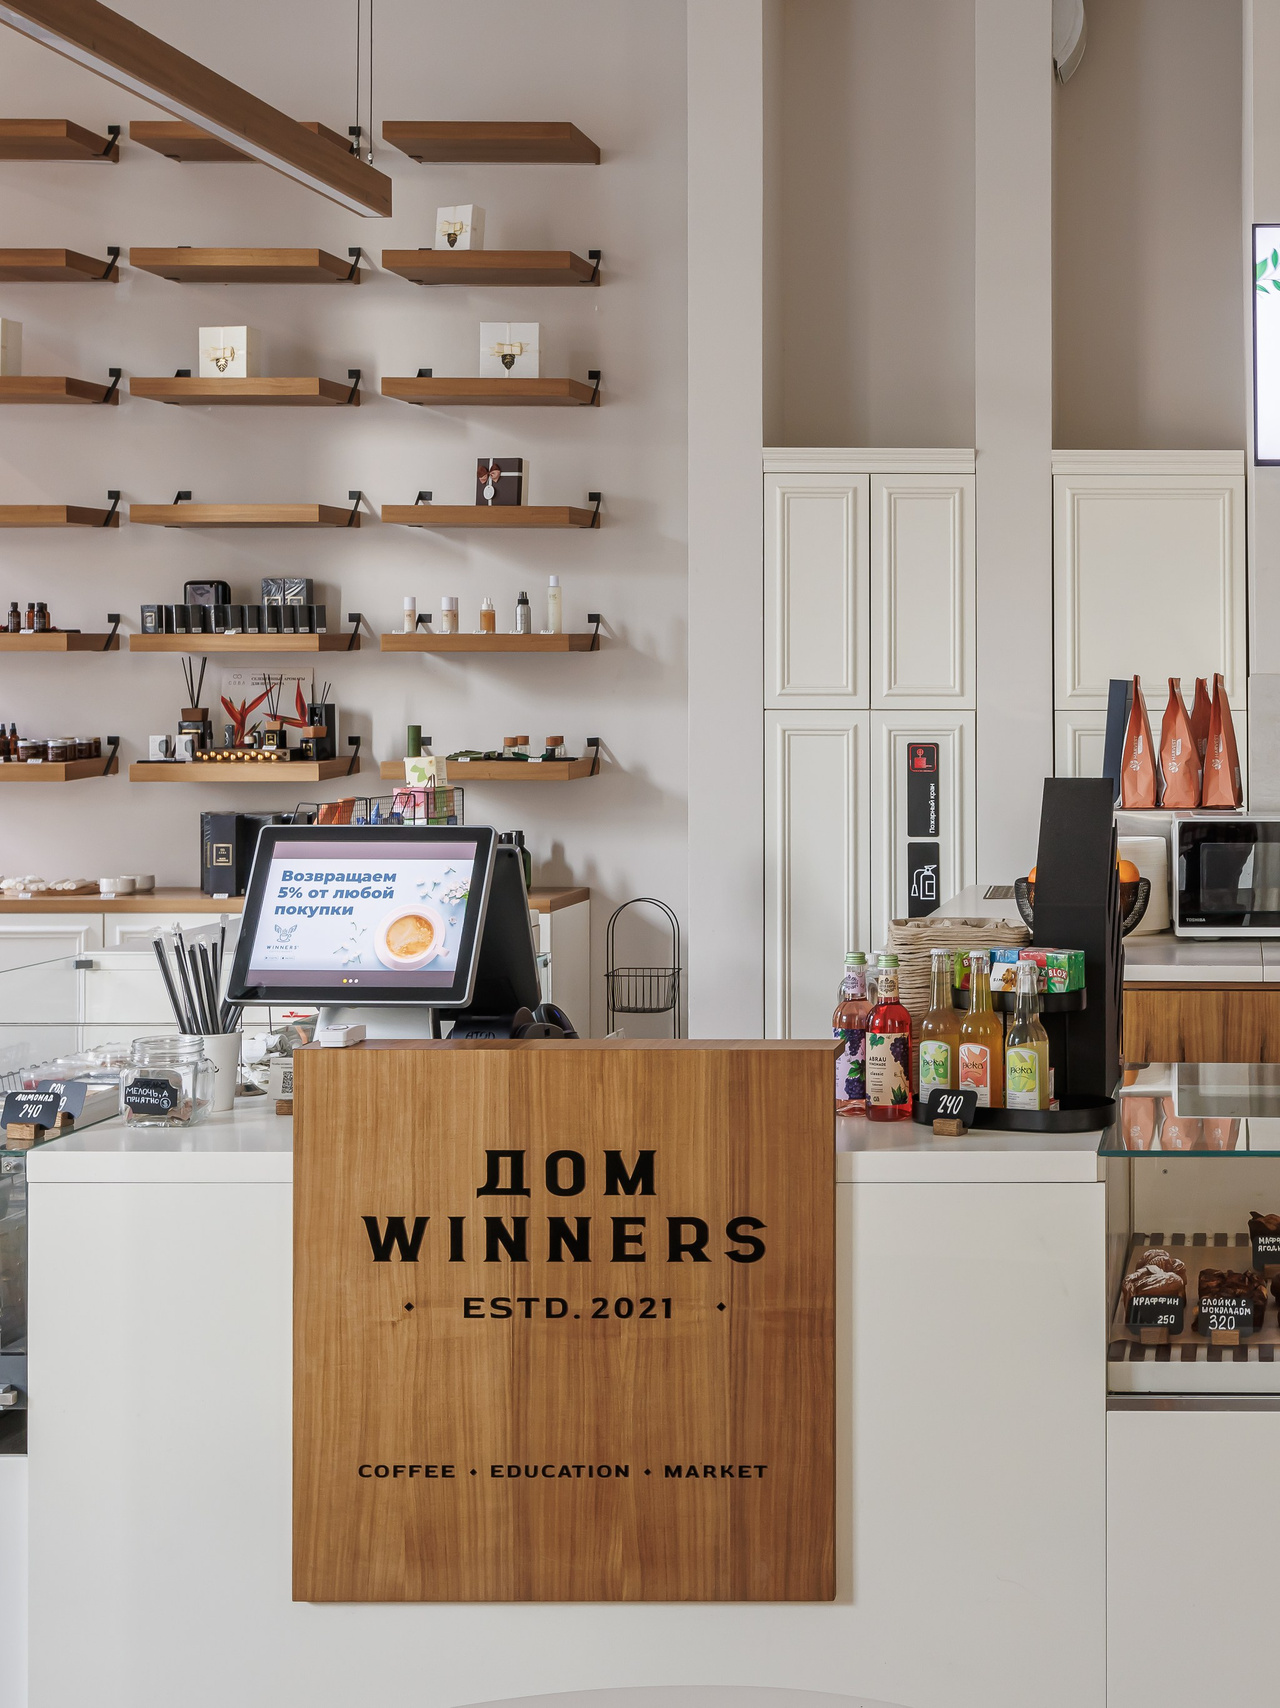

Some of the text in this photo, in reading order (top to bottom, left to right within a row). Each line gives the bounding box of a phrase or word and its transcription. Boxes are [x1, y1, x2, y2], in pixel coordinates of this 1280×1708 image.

[929, 783, 937, 834] Пожарный кран
[281, 870, 397, 885] Возвращаем
[277, 886, 395, 899] 5% от любой
[274, 905, 354, 918] покупки
[1048, 968, 1068, 980] BLOX
[15, 1093, 54, 1102] ЛИМОНАД
[126, 1097, 159, 1105] ПРИЯТНО
[18, 1104, 43, 1118] 240
[937, 1094, 964, 1115] 240
[476, 1150, 657, 1198] ДОМ
[361, 1216, 768, 1263] WINNERS
[1132, 1297, 1179, 1307] КРАФФИН
[1201, 1297, 1237, 1307] СЛОЙКА
[1201, 1306, 1252, 1315] ШОКОЛАДОМ
[1157, 1315, 1176, 1324] 250
[1208, 1314, 1236, 1330] 320
[357, 1464, 768, 1479] COFFEE EDUCATION MARKET
